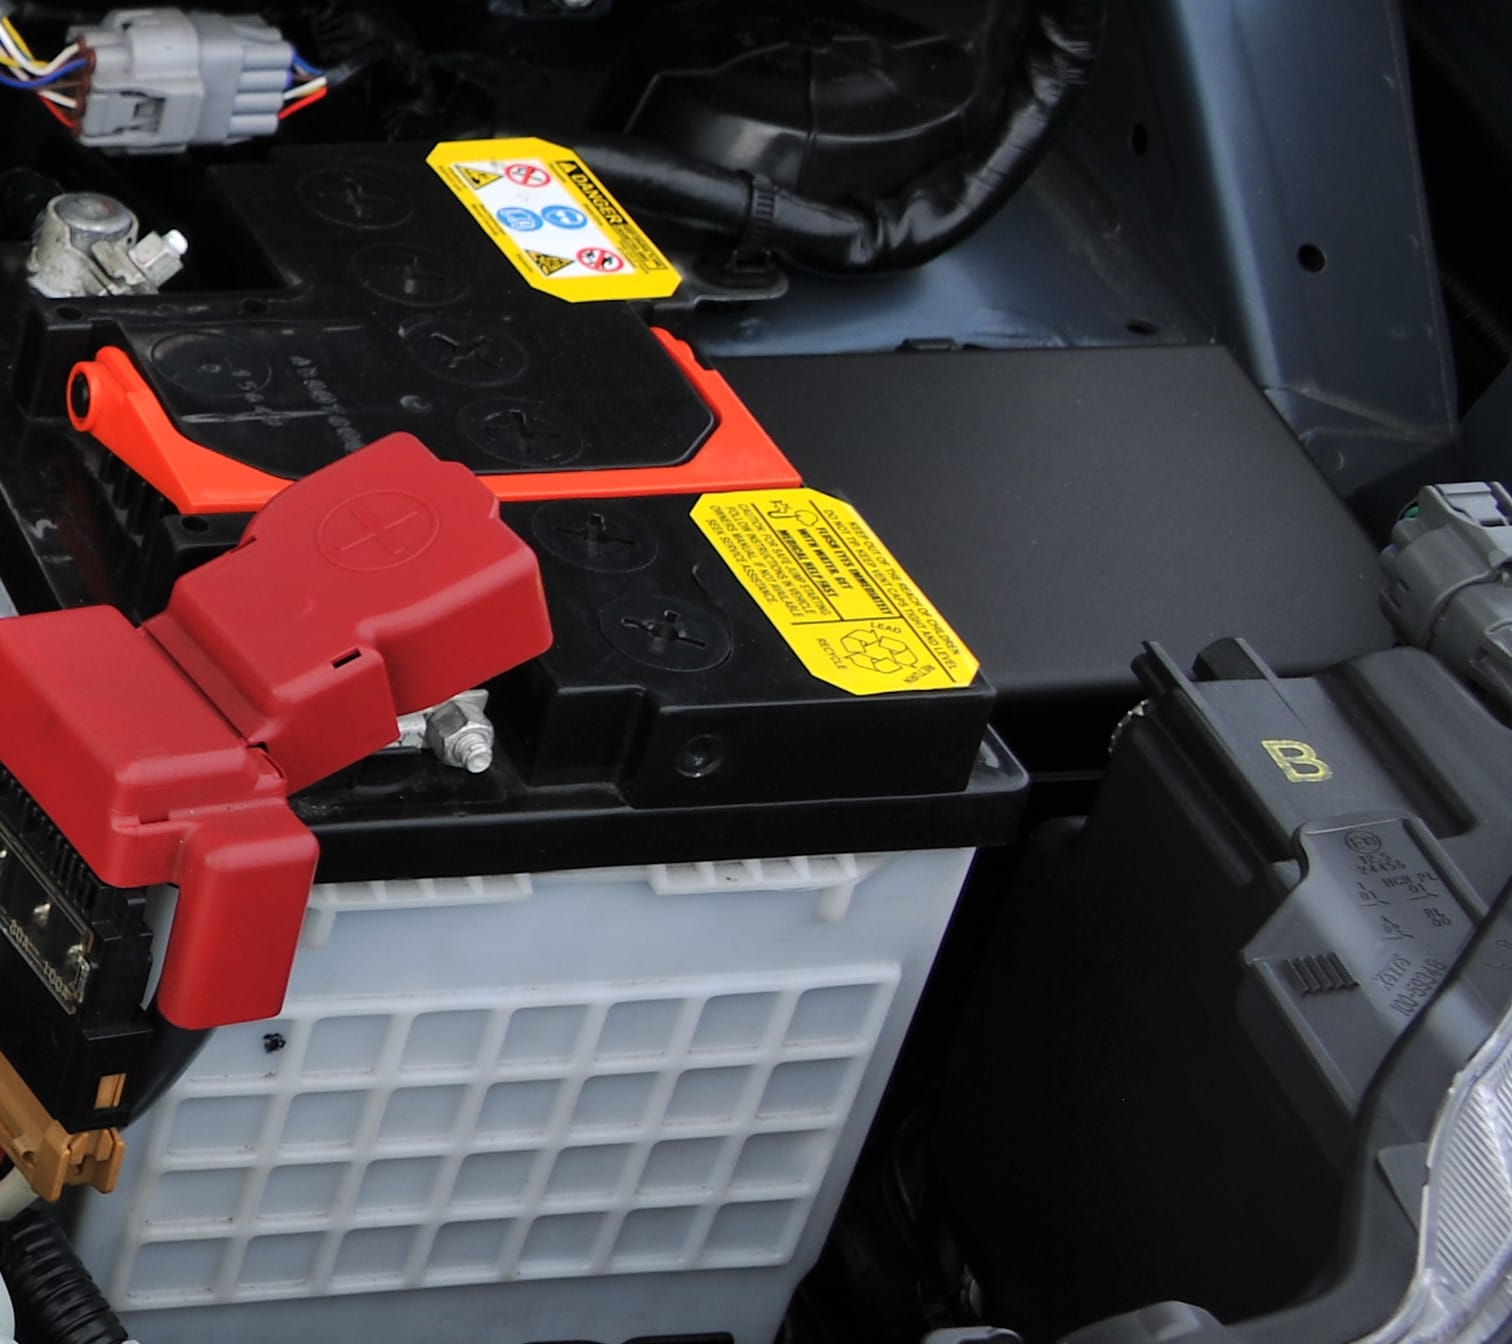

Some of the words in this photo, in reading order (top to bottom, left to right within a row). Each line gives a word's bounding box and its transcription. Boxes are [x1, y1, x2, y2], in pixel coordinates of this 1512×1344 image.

[571, 172, 628, 227] DANGER
[870, 619, 902, 634] LEAD
[815, 638, 847, 670] RECYCLE
[1261, 739, 1332, 783] B
